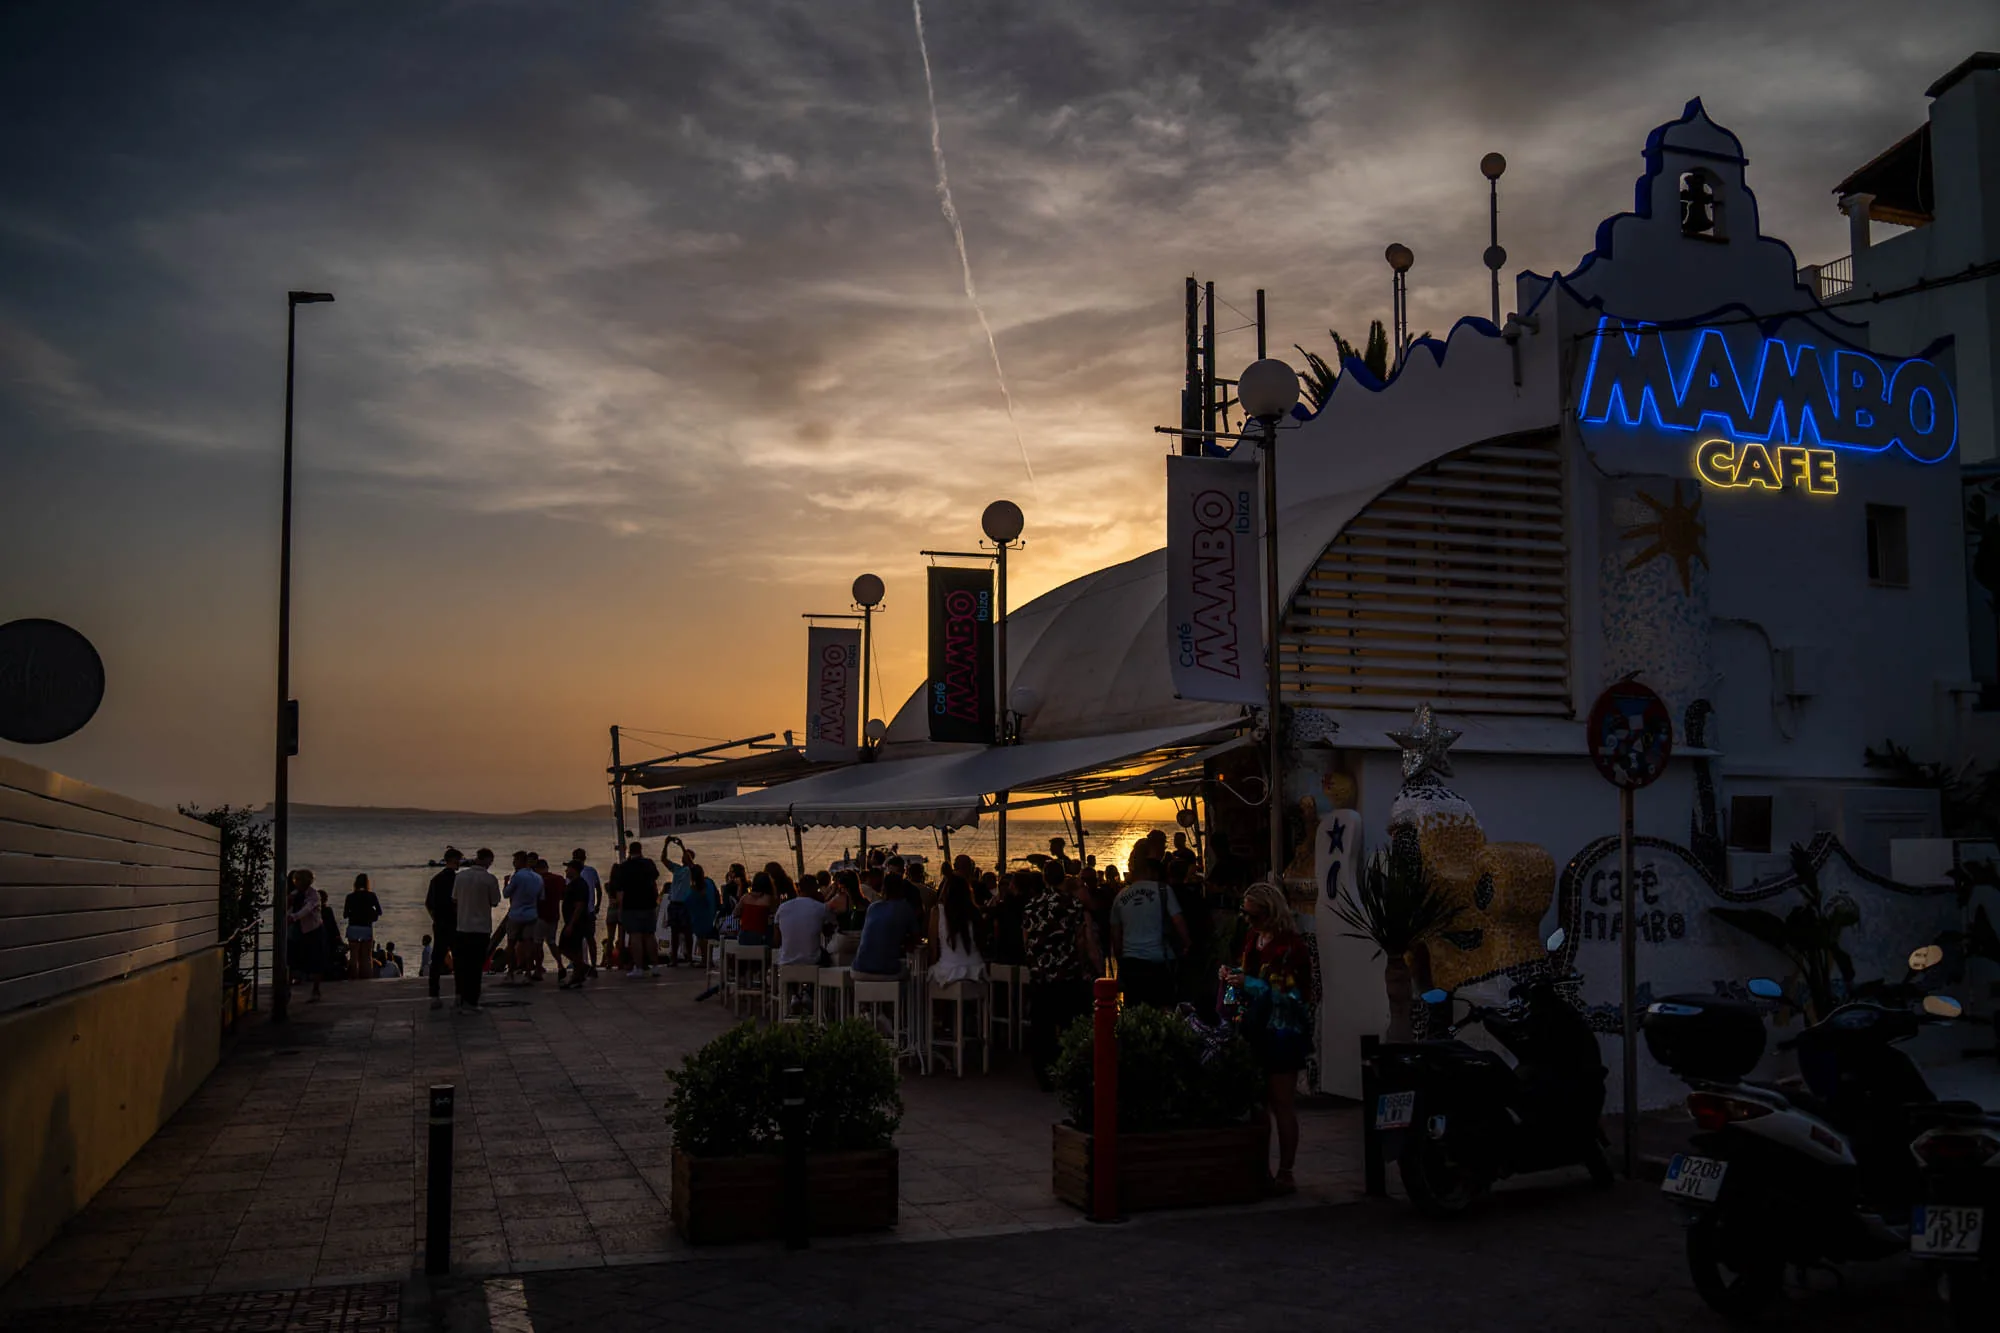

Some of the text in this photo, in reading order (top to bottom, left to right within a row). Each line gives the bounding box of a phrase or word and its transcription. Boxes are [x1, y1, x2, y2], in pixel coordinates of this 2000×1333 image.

[1579, 316, 1959, 464] MAMBO
[1696, 439, 1839, 495] CAFE
[1236, 491, 1250, 534] Ibiza
[977, 590, 989, 622] Ibiza
[1193, 490, 1241, 680] MAMBO
[945, 589, 980, 724] MAMBO
[1177, 622, 1194, 668] Café
[821, 644, 847, 746] MAMBO
[933, 680, 947, 716] Café
[1682, 1159, 1722, 1180] 0208
[1928, 1209, 1978, 1230] 7516
